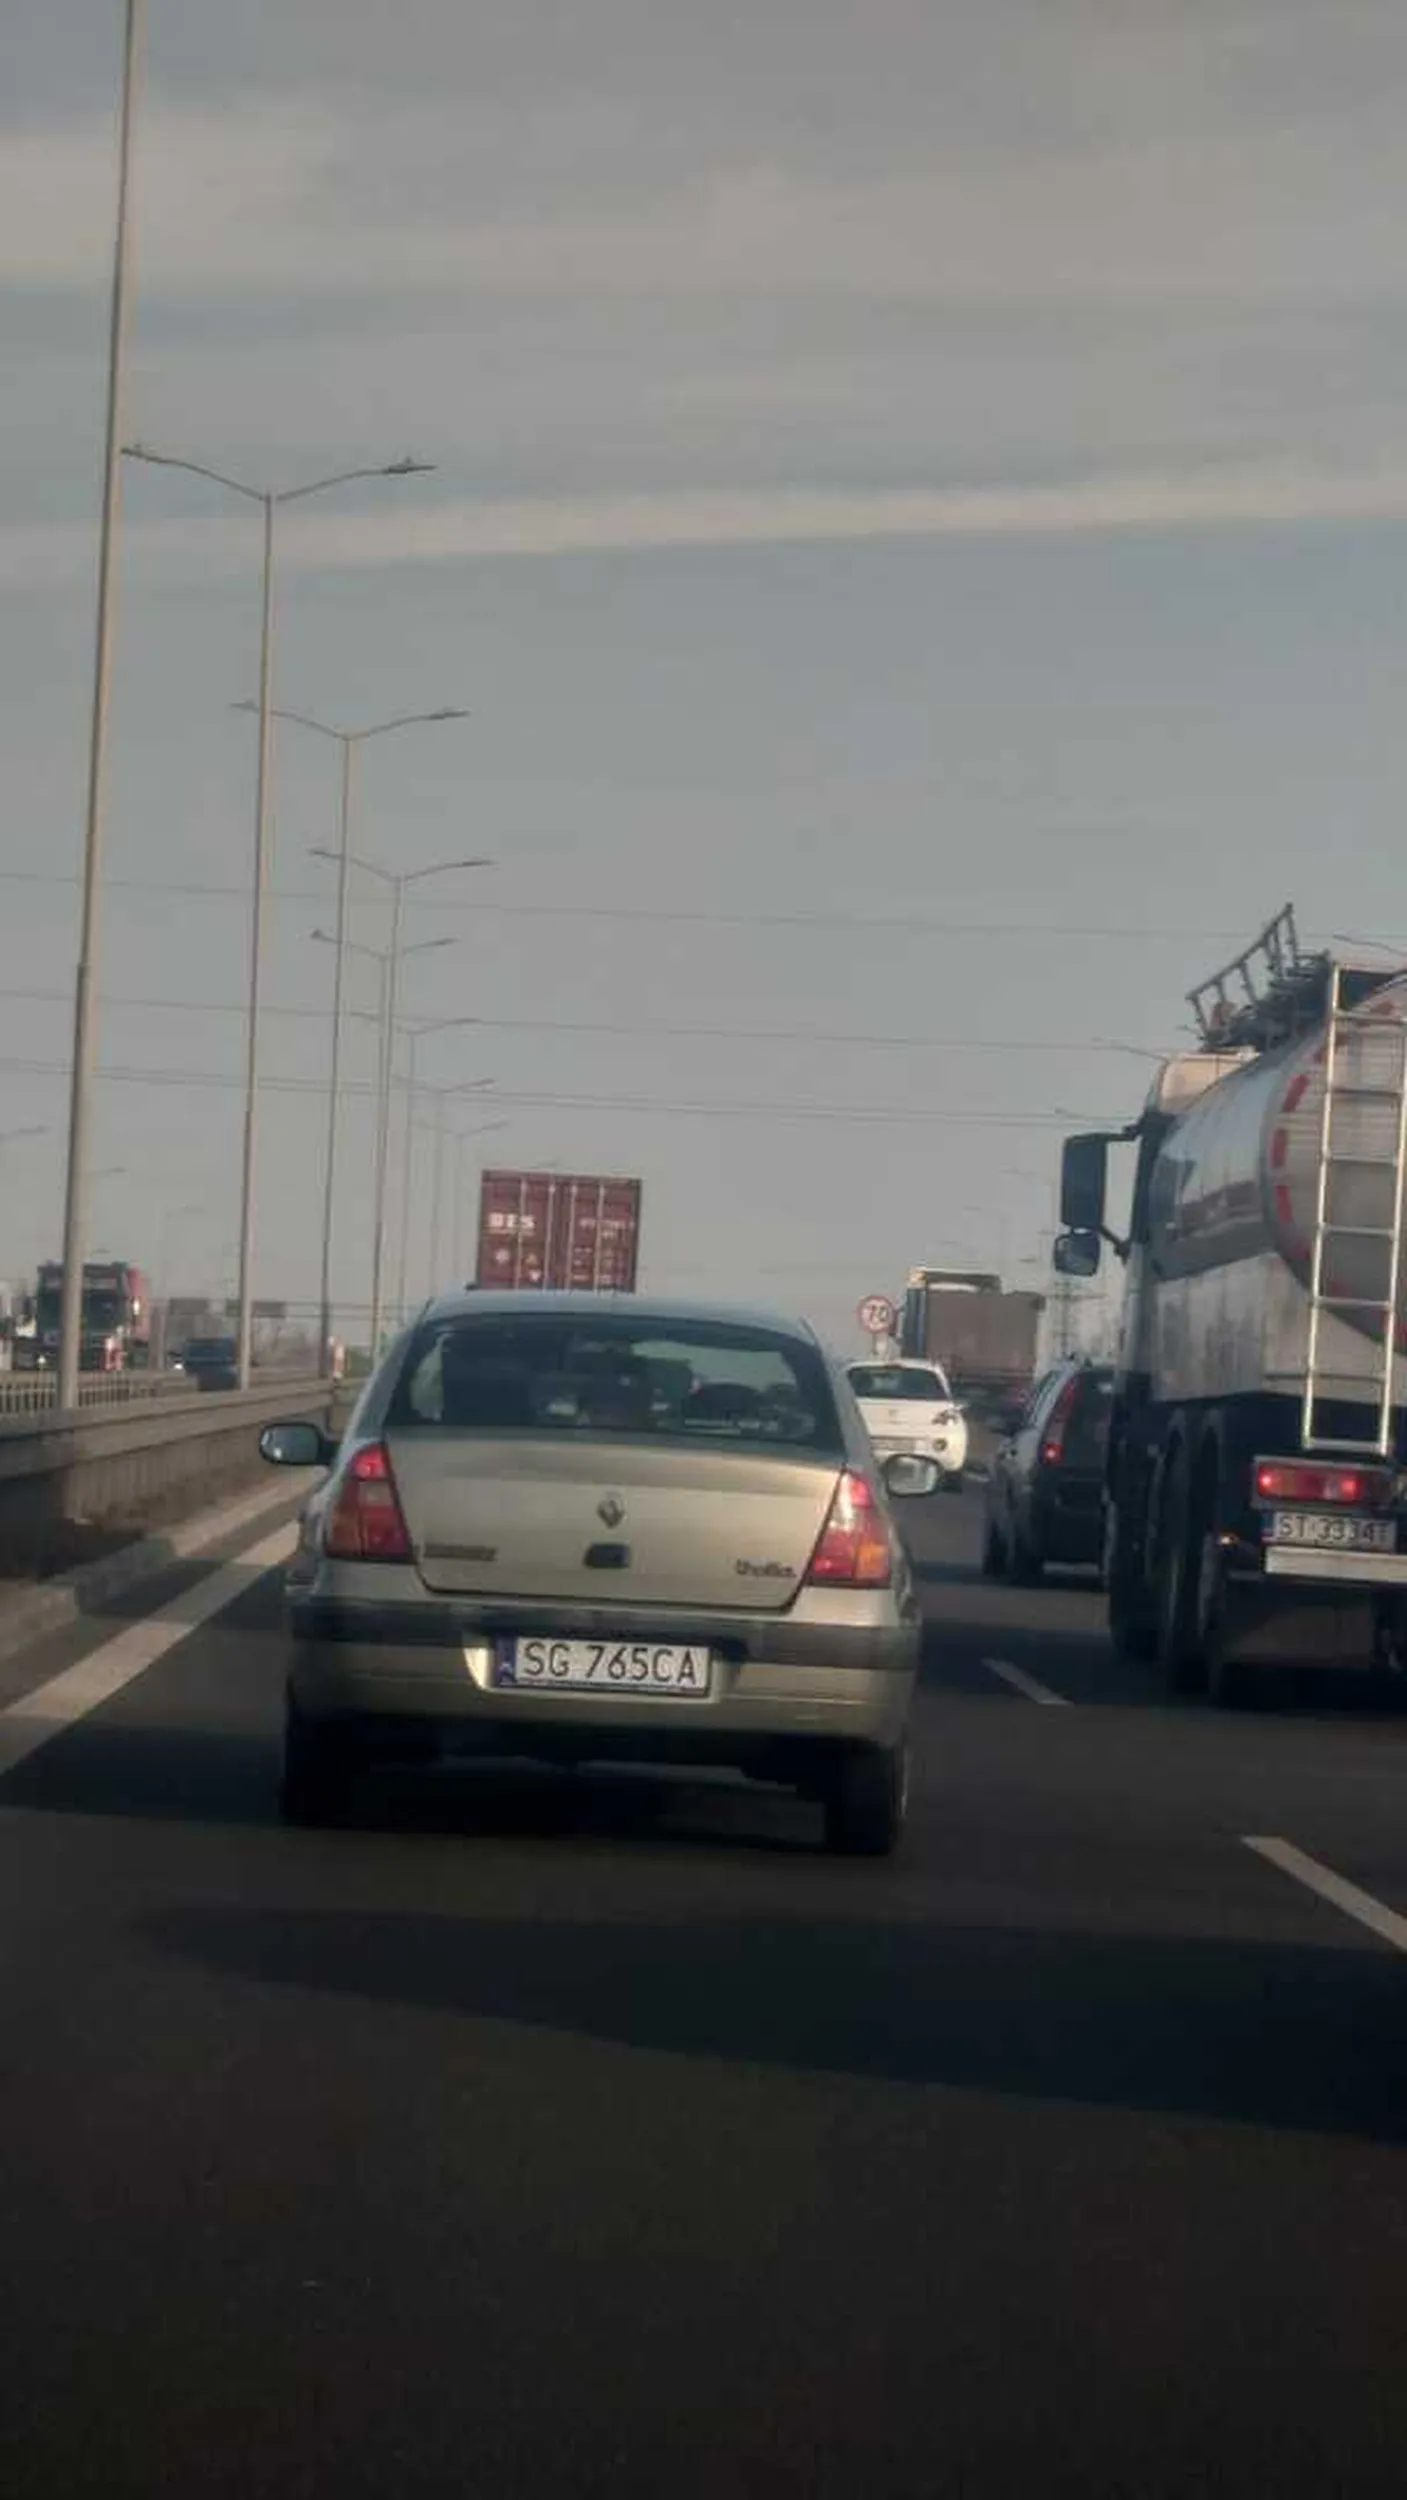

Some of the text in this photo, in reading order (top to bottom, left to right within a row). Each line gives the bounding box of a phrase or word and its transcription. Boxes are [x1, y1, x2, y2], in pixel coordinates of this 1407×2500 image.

[866, 1304, 889, 1323] 70
[1279, 1514, 1307, 1537] ST
[523, 1641, 570, 1678] SG
[584, 1644, 696, 1684] 765CA
